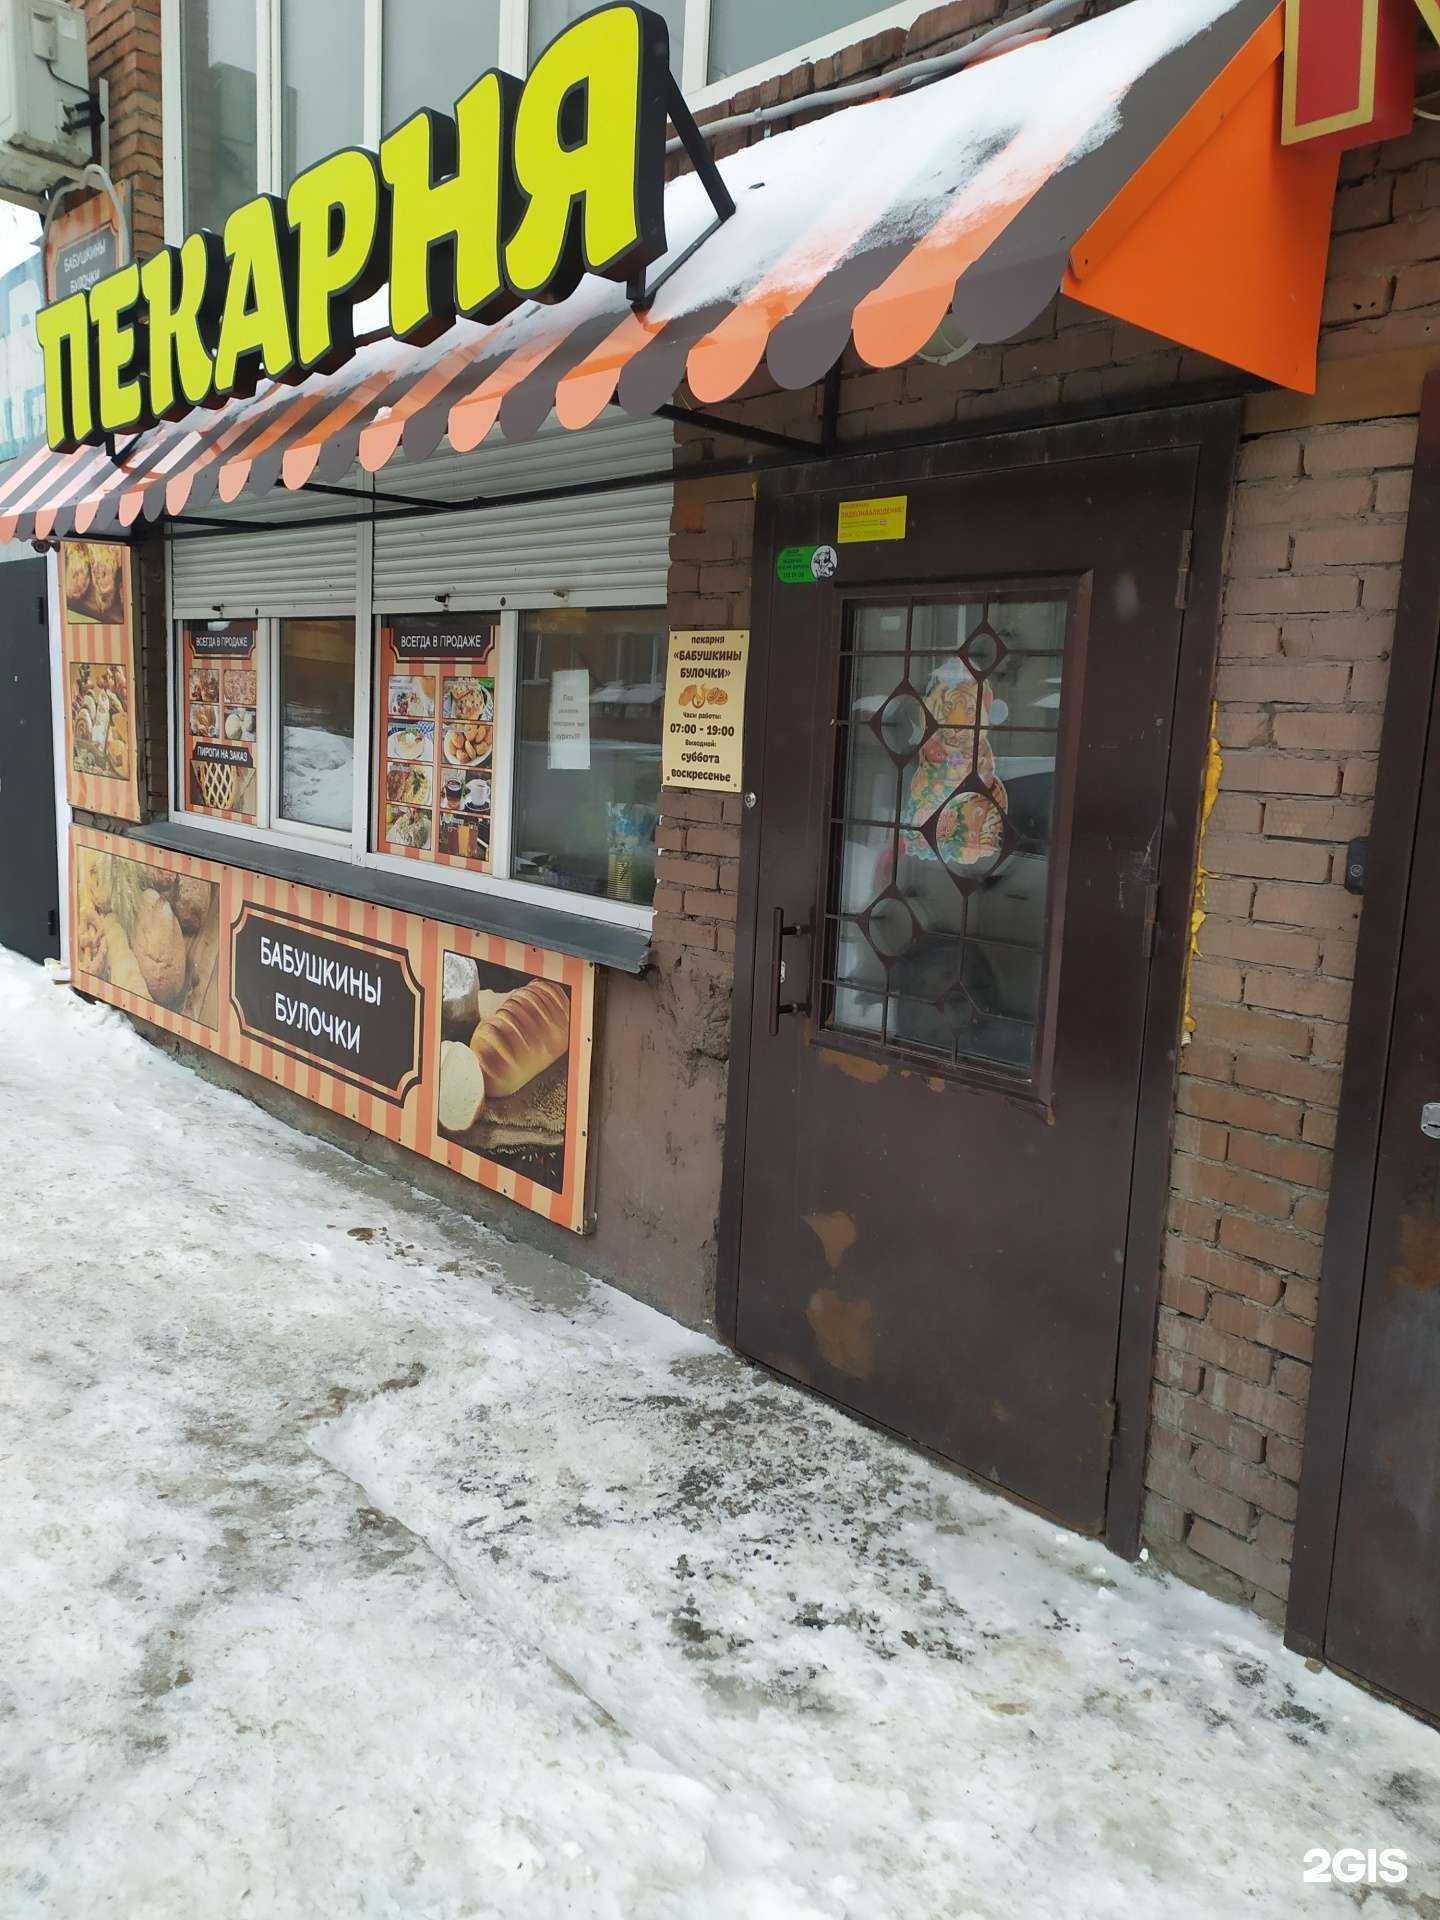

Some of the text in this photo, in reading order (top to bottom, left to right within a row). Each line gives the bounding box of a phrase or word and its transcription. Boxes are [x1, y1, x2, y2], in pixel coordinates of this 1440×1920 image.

[36, 2, 643, 453] ПЕКАРНЯ
[195, 635, 248, 648] ВСЕГДА В ПРОДАЖЕ
[400, 634, 482, 649] ВСЕГДА В ПРОДАЖЕ
[690, 635, 725, 645] пекарня
[673, 650, 742, 662] «БАБУШКИНЫ
[680, 667, 732, 679] БУЛОЧКИ»
[669, 723, 697, 734] 07:00
[706, 724, 735, 737] 19:00
[197, 746, 248, 762] ПИРОГИ НА ЗАКАЗ
[680, 751, 720, 764] суббота
[671, 768, 731, 783] воскресенье
[260, 936, 382, 1006] БАБУШКИНЫ
[275, 992, 361, 1054] БУЛОЧКИ
